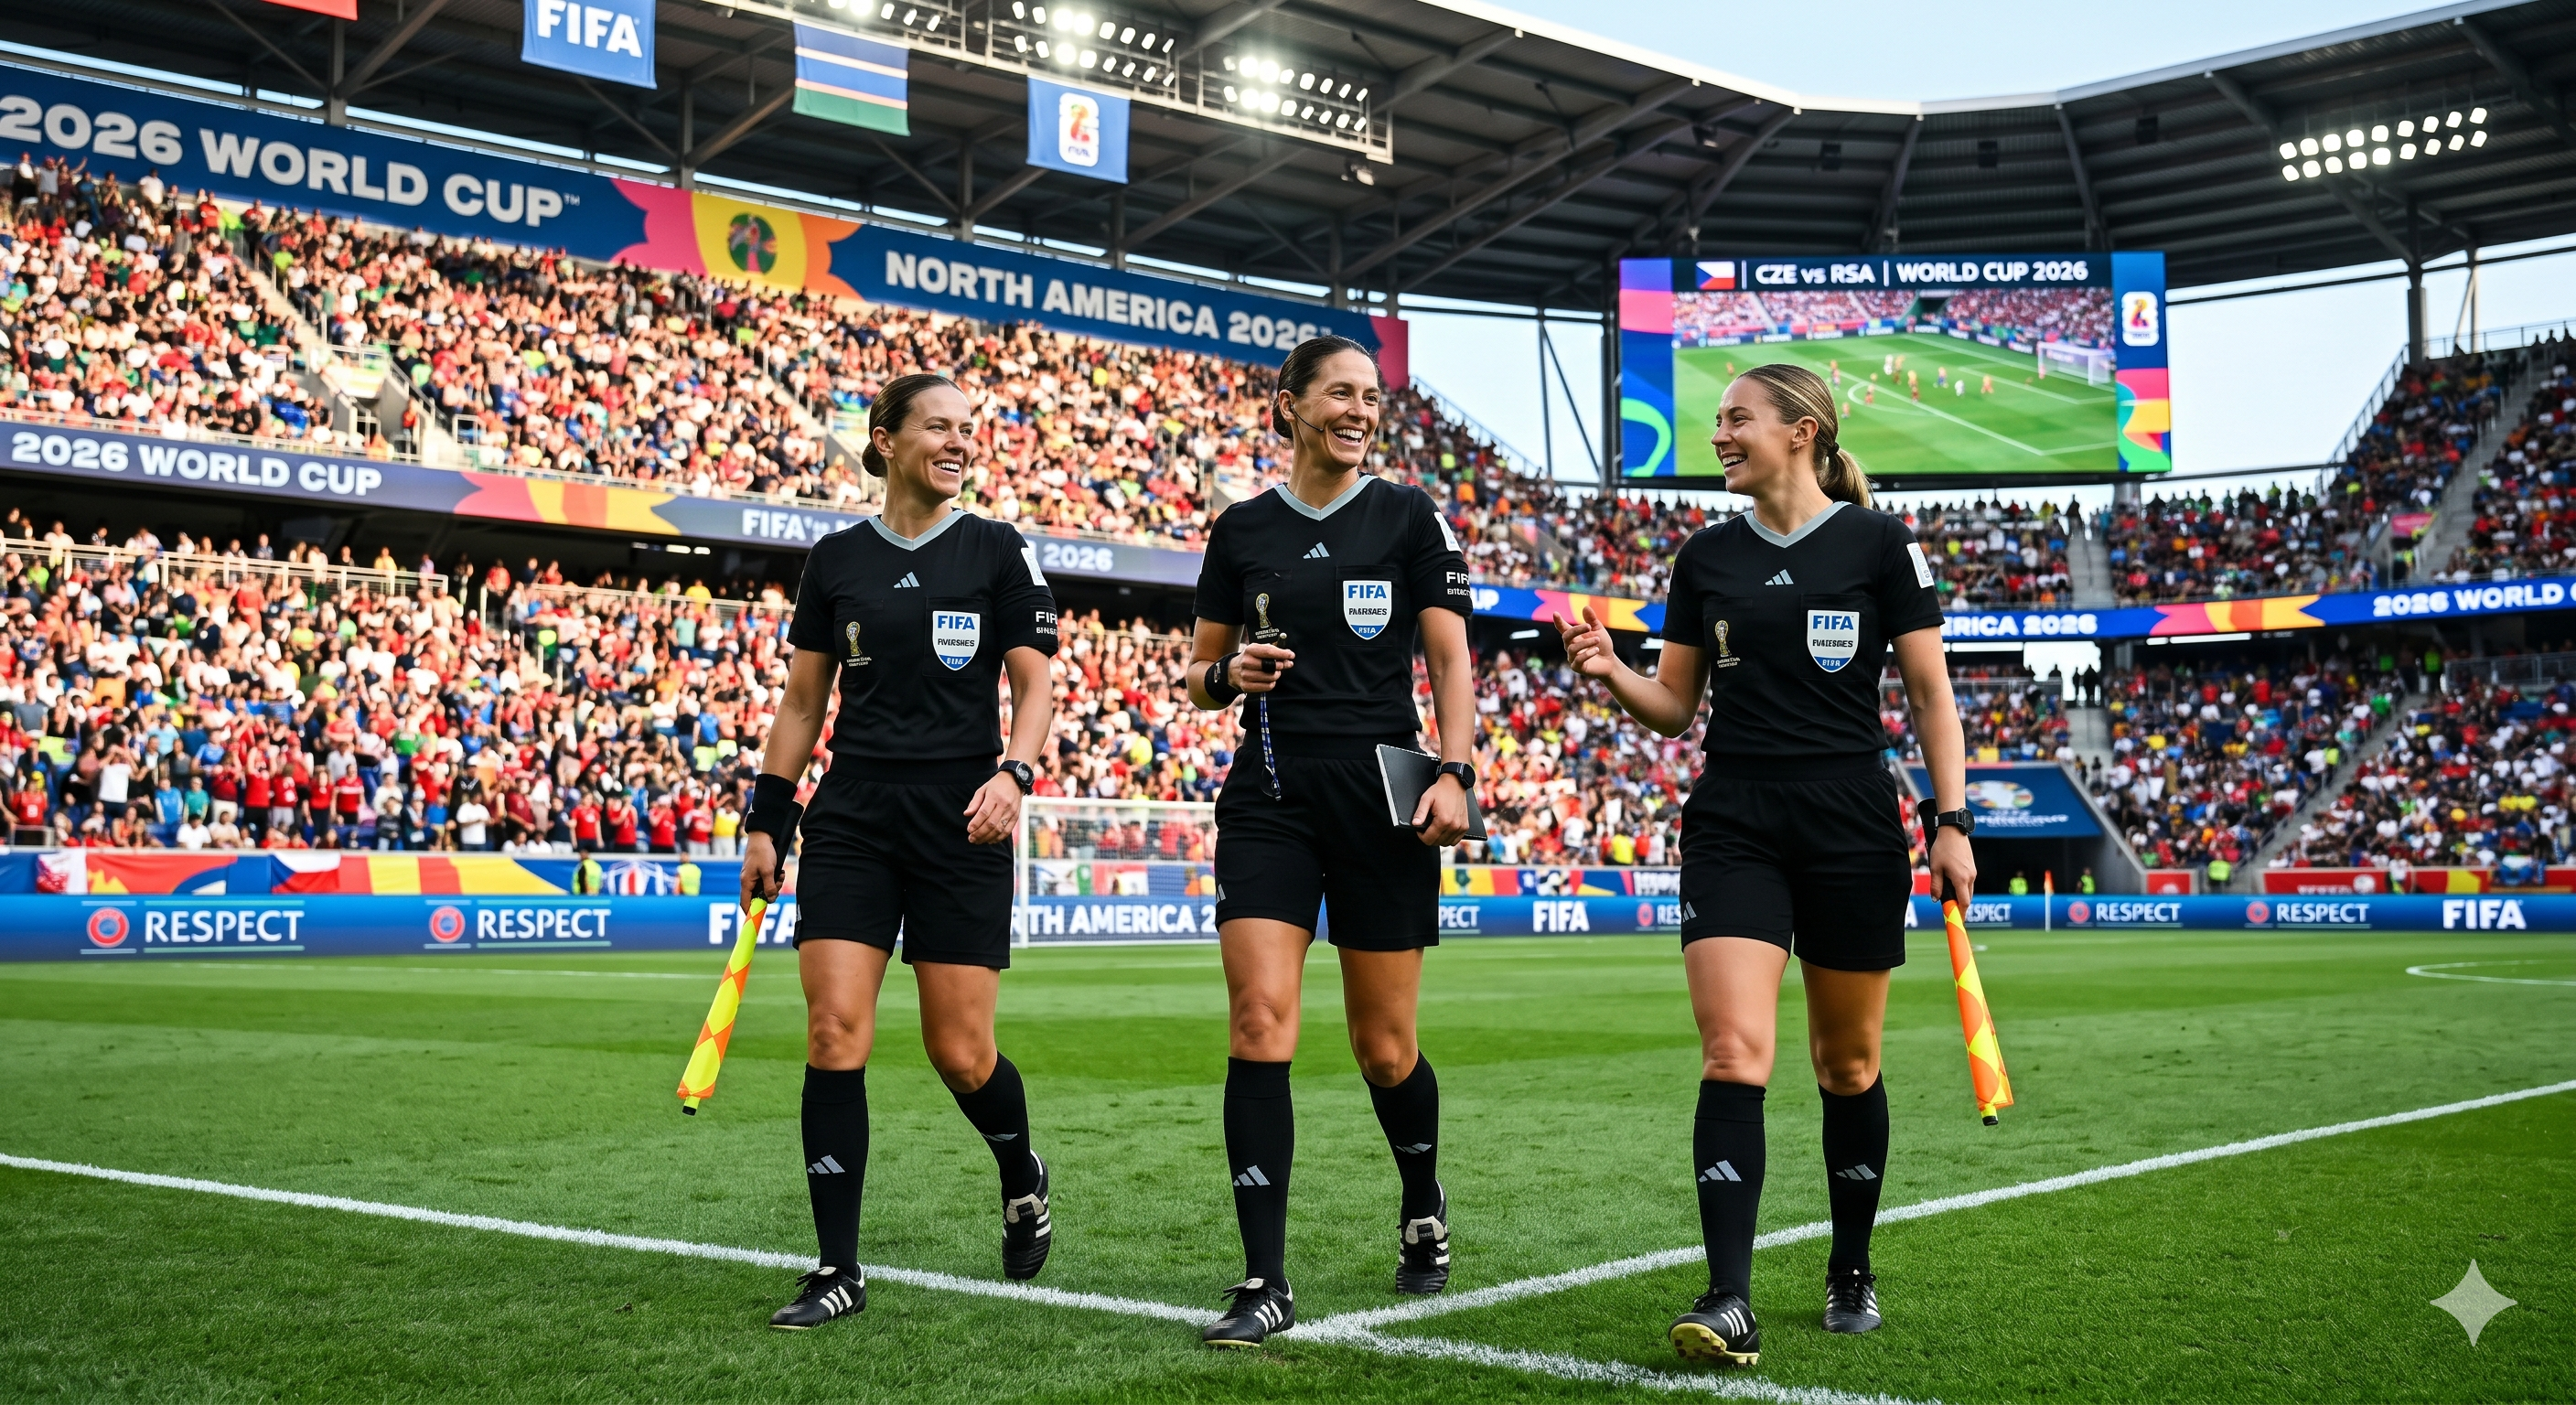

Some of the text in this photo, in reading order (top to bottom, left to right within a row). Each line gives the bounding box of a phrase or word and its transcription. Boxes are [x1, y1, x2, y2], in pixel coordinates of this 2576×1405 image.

[538, 0, 642, 58] FIFA
[0, 94, 183, 166] 2026
[199, 127, 429, 207] WORLD
[1755, 260, 2089, 284] CZE vs RSA WORLD CUP 2026
[886, 250, 1034, 309] NORTH
[1041, 278, 1220, 340] AMERICA
[12, 431, 383, 497] 2026 WORLD CUP
[1042, 542, 1114, 573] 2026
[1348, 585, 1387, 599] FIFA
[1470, 587, 1500, 611] UP
[2373, 591, 2450, 617] 2026
[2453, 583, 2565, 611] WORLD
[938, 615, 975, 630] FIFA
[1812, 615, 1854, 630] FIFA
[1940, 614, 2098, 637] ERICA 2026
[145, 910, 306, 943] RESPECT
[477, 908, 612, 939] RESPECT
[1068, 904, 1197, 935] AMERICA
[1439, 905, 1481, 928] PECT
[1532, 900, 1591, 933] FIFA
[1965, 903, 2012, 923] ESPECT
[2096, 902, 2183, 922] RESPECT
[2276, 903, 2371, 923] RESPECT
[2442, 899, 2528, 929] FIFA
